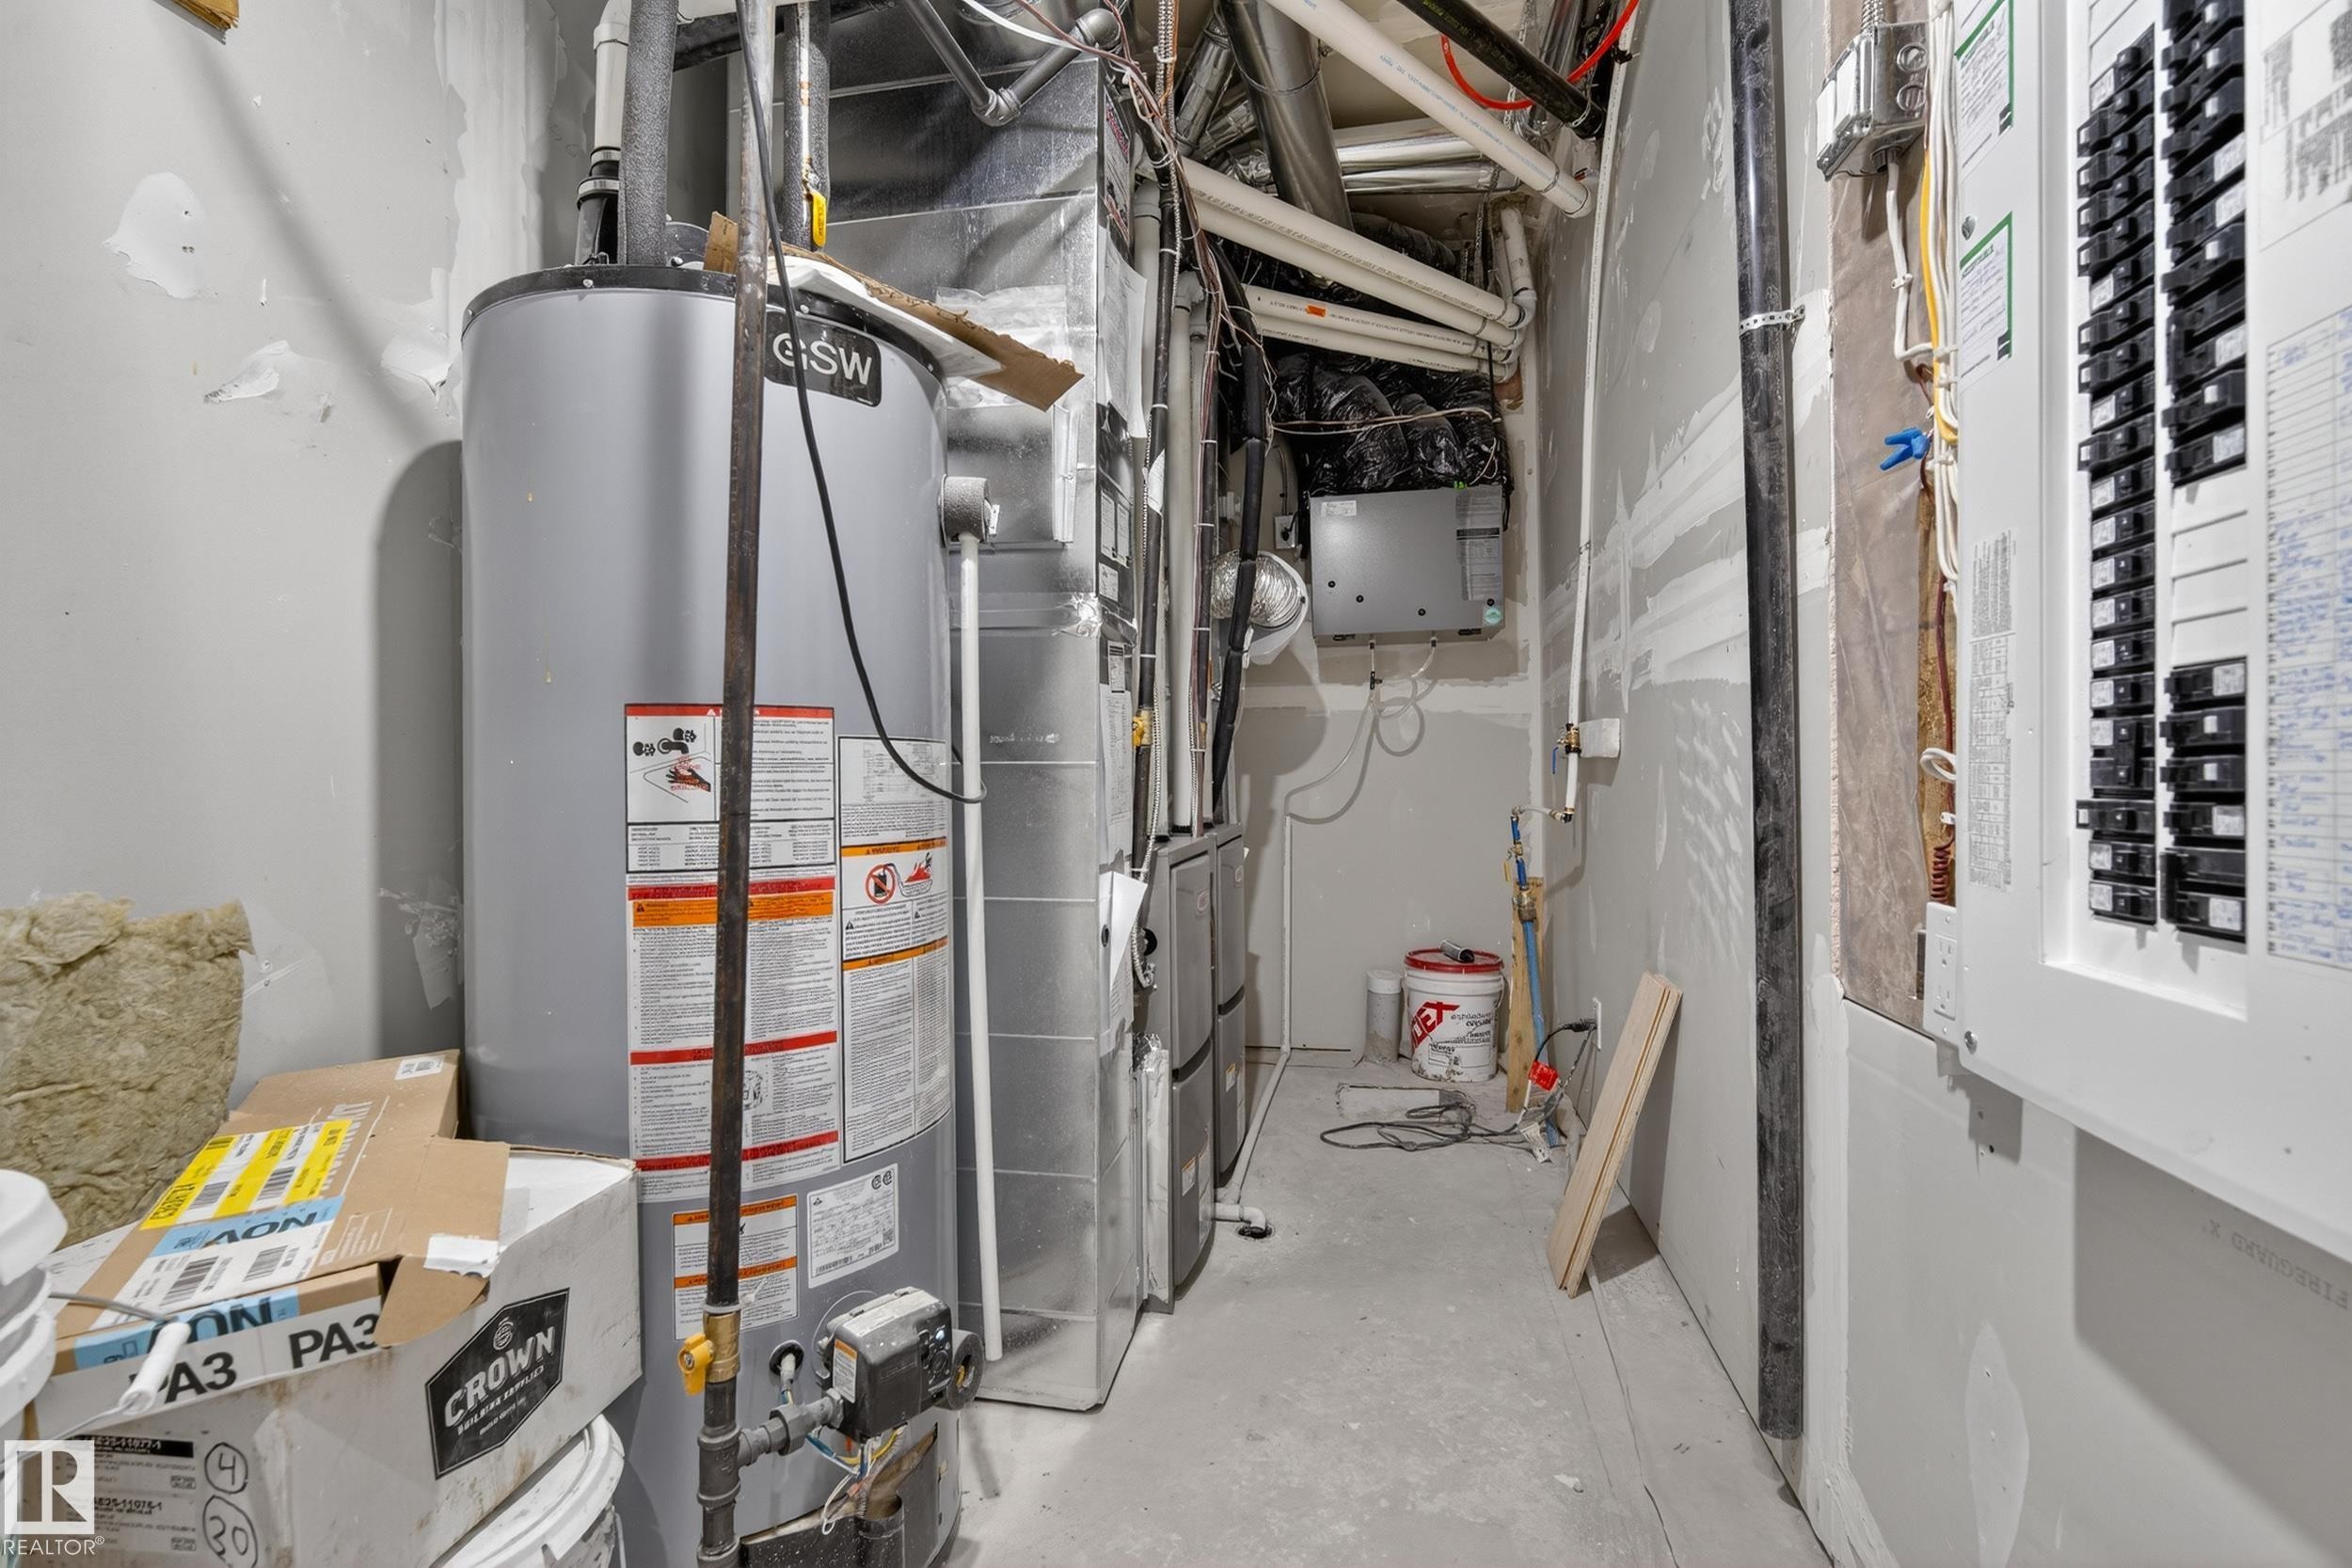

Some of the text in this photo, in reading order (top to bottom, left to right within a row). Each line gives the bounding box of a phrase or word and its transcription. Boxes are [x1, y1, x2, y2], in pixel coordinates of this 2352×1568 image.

[772, 333, 872, 385] GSW
[289, 1313, 380, 1370] PA3
[444, 1326, 556, 1428] CROWN
[217, 1452, 236, 1485] 4
